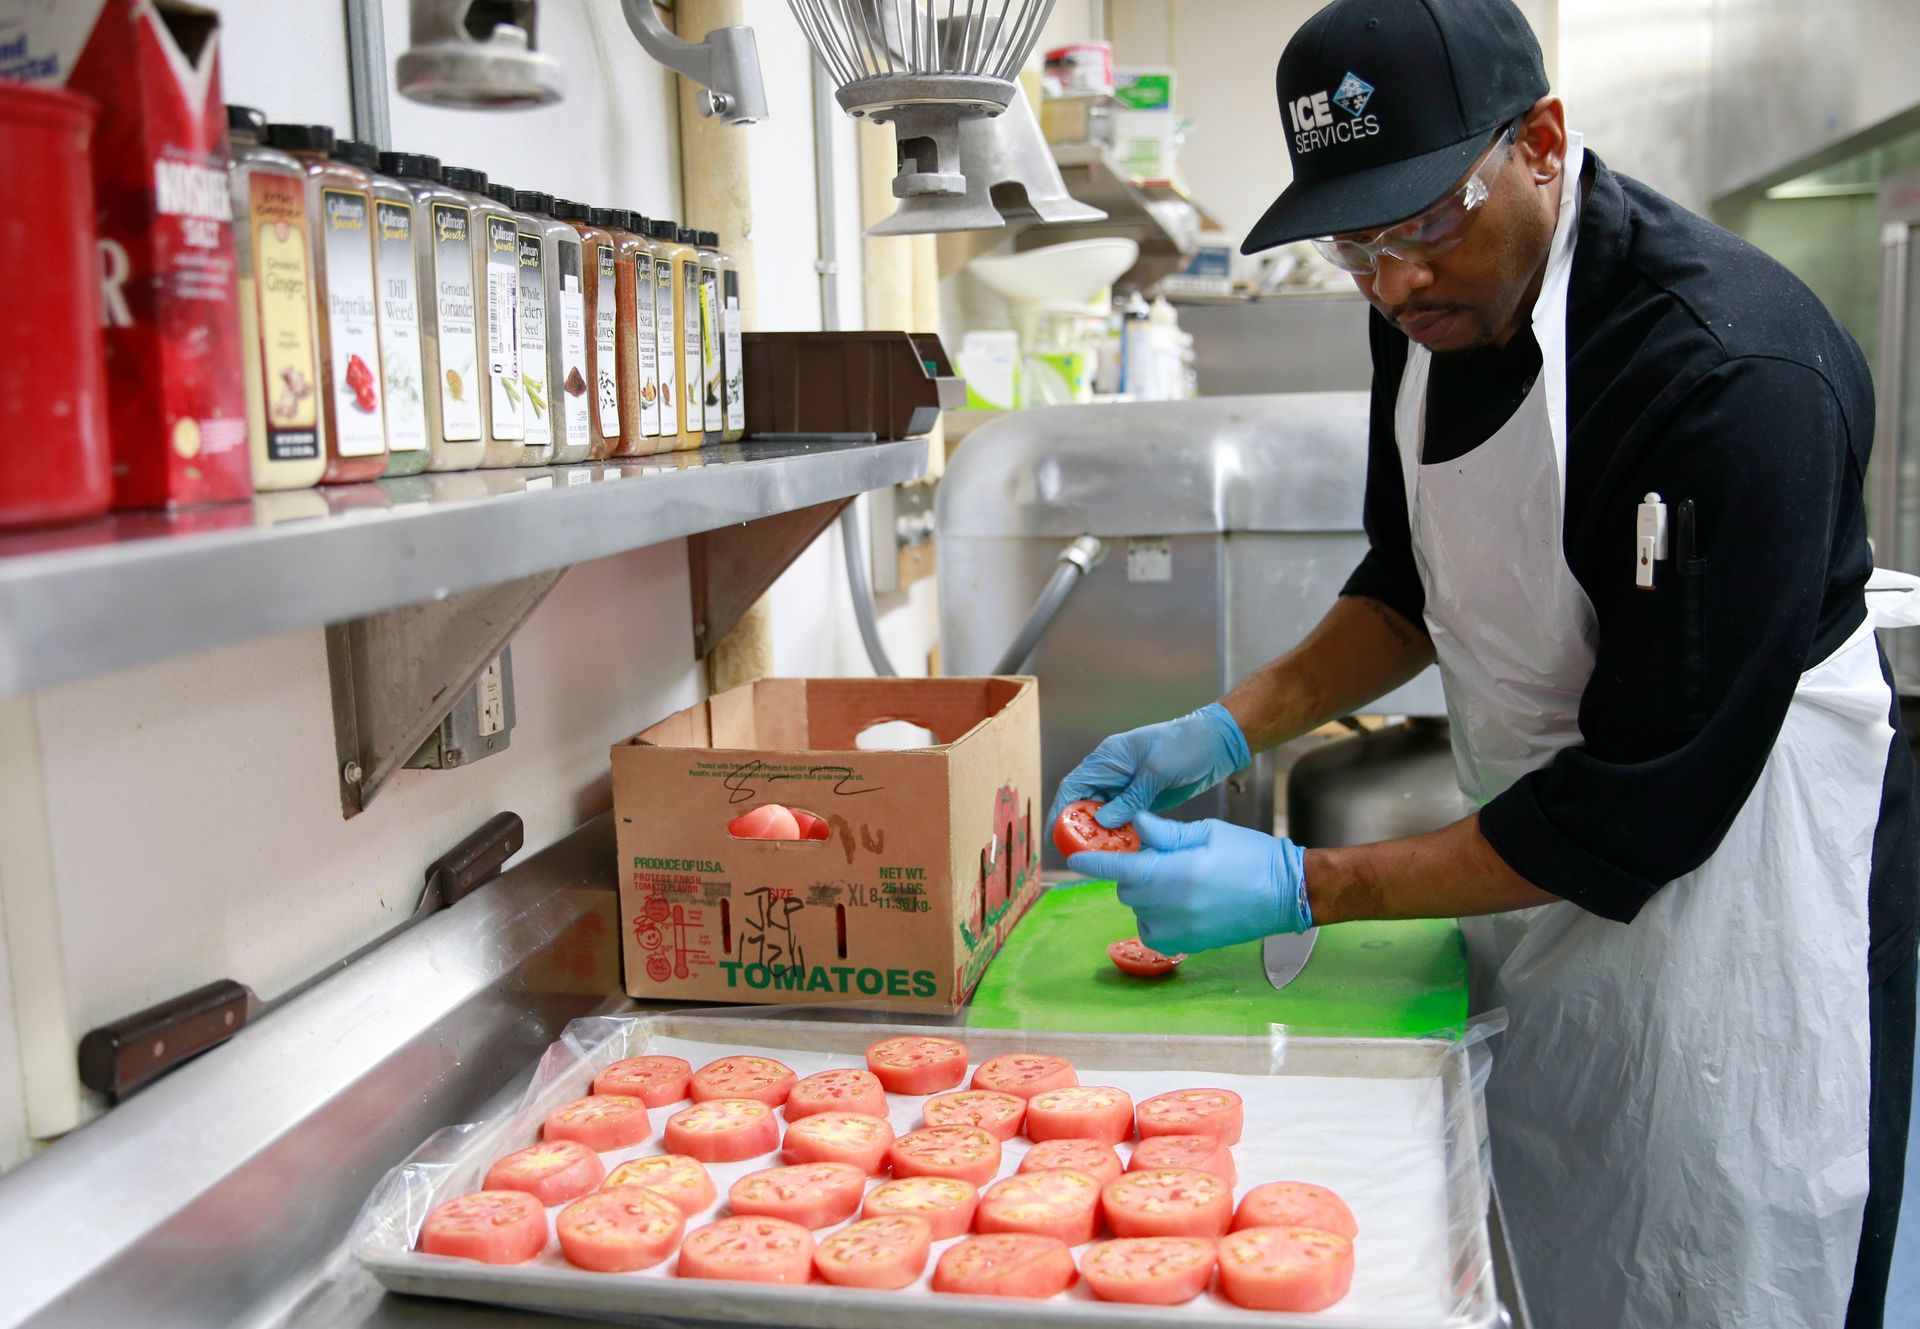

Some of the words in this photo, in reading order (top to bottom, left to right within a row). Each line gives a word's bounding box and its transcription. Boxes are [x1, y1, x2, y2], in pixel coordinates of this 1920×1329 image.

[1288, 90, 1334, 133] ICE
[1295, 114, 1380, 154] SERVICES
[328, 197, 364, 222] Culinary
[379, 209, 409, 231] Culinary
[437, 211, 466, 232] Culinary
[490, 224, 516, 246] Culinary
[266, 272, 305, 299] Ginger
[388, 278, 408, 299] Dill
[441, 280, 471, 297] Ground
[520, 286, 541, 301] Whole
[331, 293, 375, 322] Paprika
[385, 301, 414, 322] Weed
[440, 298, 473, 318] Coriander
[524, 322, 539, 336] Seed
[634, 857, 681, 872] PRODUCE
[682, 859, 696, 872] OF
[696, 860, 725, 873] U.S.A.
[880, 867, 903, 879] NET
[905, 867, 927, 880] WT.
[633, 872, 672, 884] PROTECT
[634, 881, 666, 893] TOMATO
[768, 888, 793, 900] SIZE
[881, 882, 897, 894] 25
[900, 882, 927, 896] LBS.
[719, 961, 937, 998] TOMATOES
